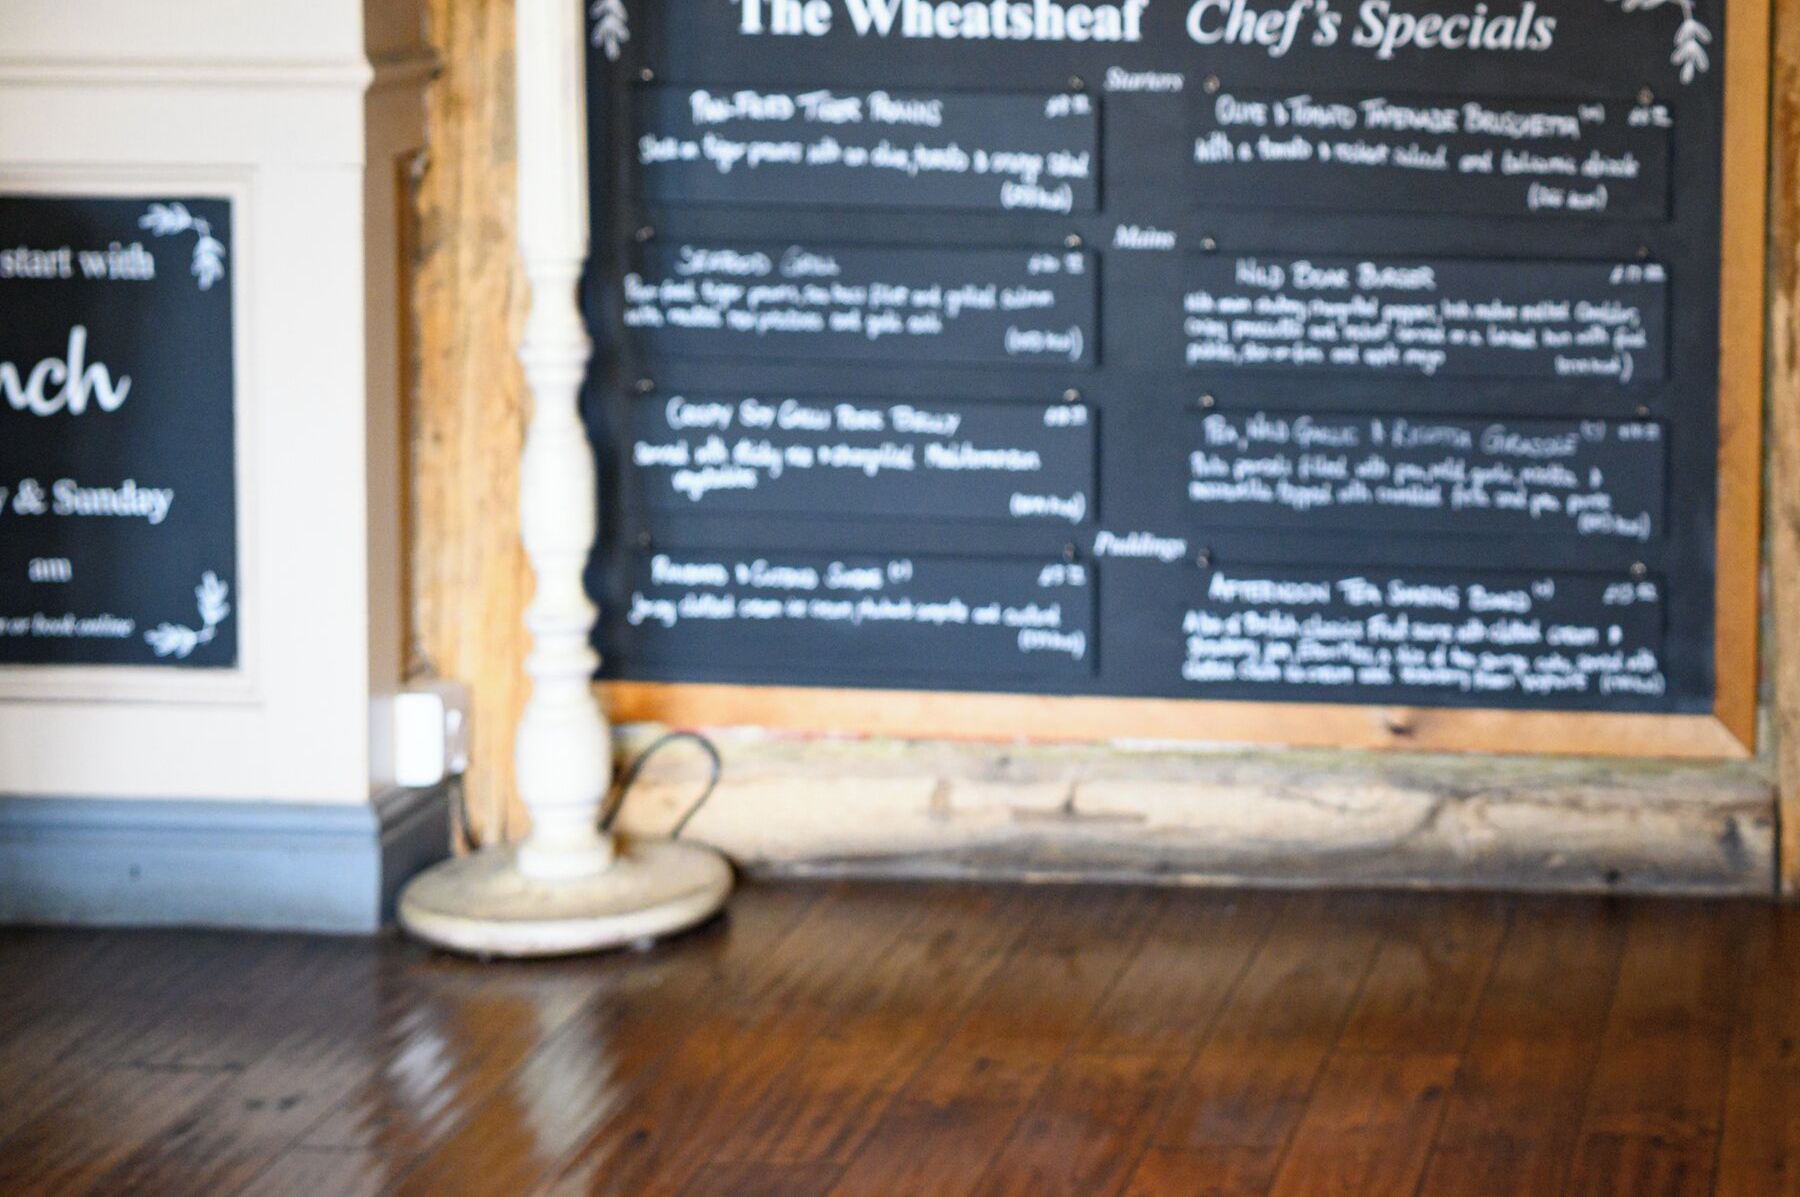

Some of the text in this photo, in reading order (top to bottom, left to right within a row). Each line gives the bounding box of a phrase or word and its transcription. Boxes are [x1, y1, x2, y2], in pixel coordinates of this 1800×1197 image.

[1216, 94, 1268, 127] OLIVE
[1287, 94, 1356, 129] TOMATO
[1360, 98, 1459, 134] TAPENADE
[1462, 102, 1580, 140] BRUSCHETTA
[0, 242, 157, 281] start with
[1356, 260, 1438, 291] BURGER
[12, 477, 174, 525] & Sunday
[28, 557, 74, 583] am
